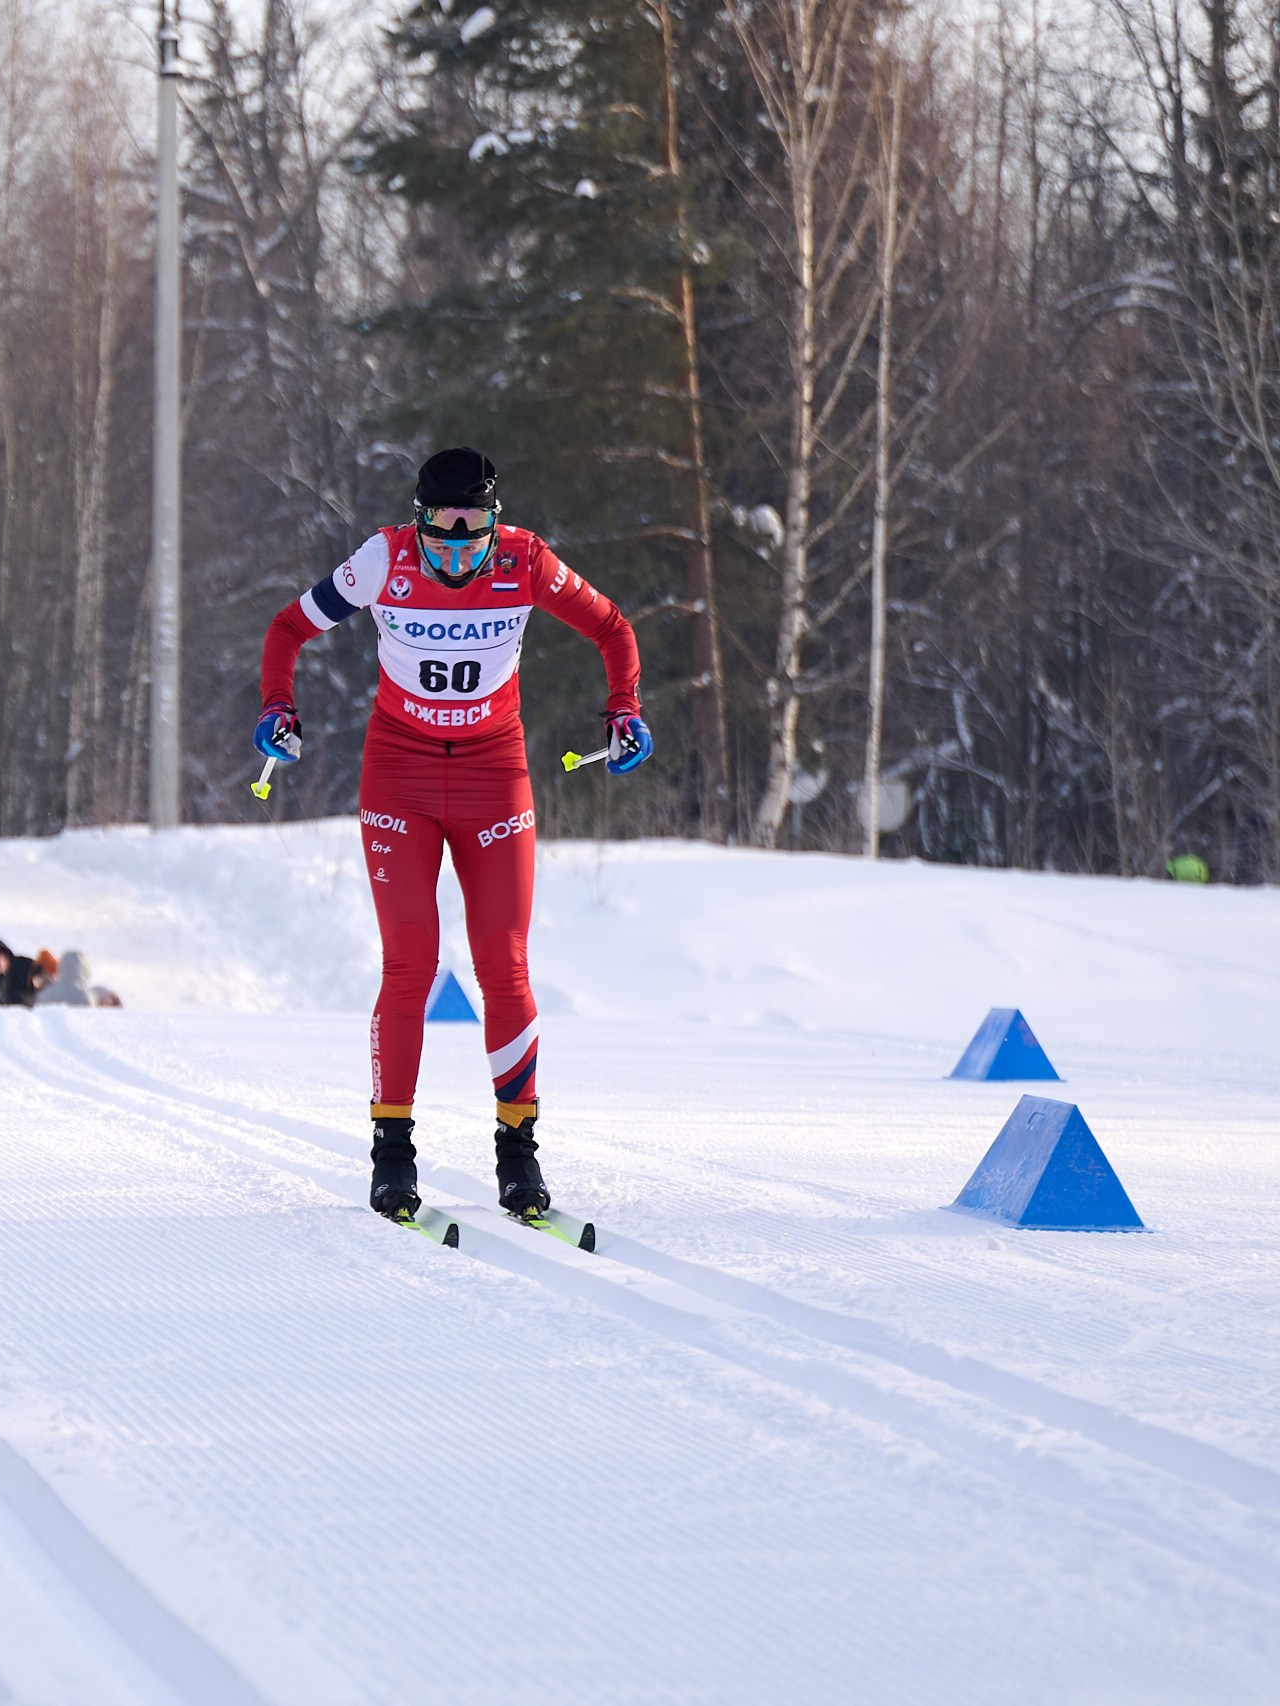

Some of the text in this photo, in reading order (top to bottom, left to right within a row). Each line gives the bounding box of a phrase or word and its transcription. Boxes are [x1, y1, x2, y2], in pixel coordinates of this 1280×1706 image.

[404, 616, 520, 641] ФОСАГРО
[418, 660, 481, 693] 60
[403, 698, 492, 727] ИЖЕВСК
[361, 808, 408, 835] LUKOIL
[477, 809, 535, 848] BOSCO
